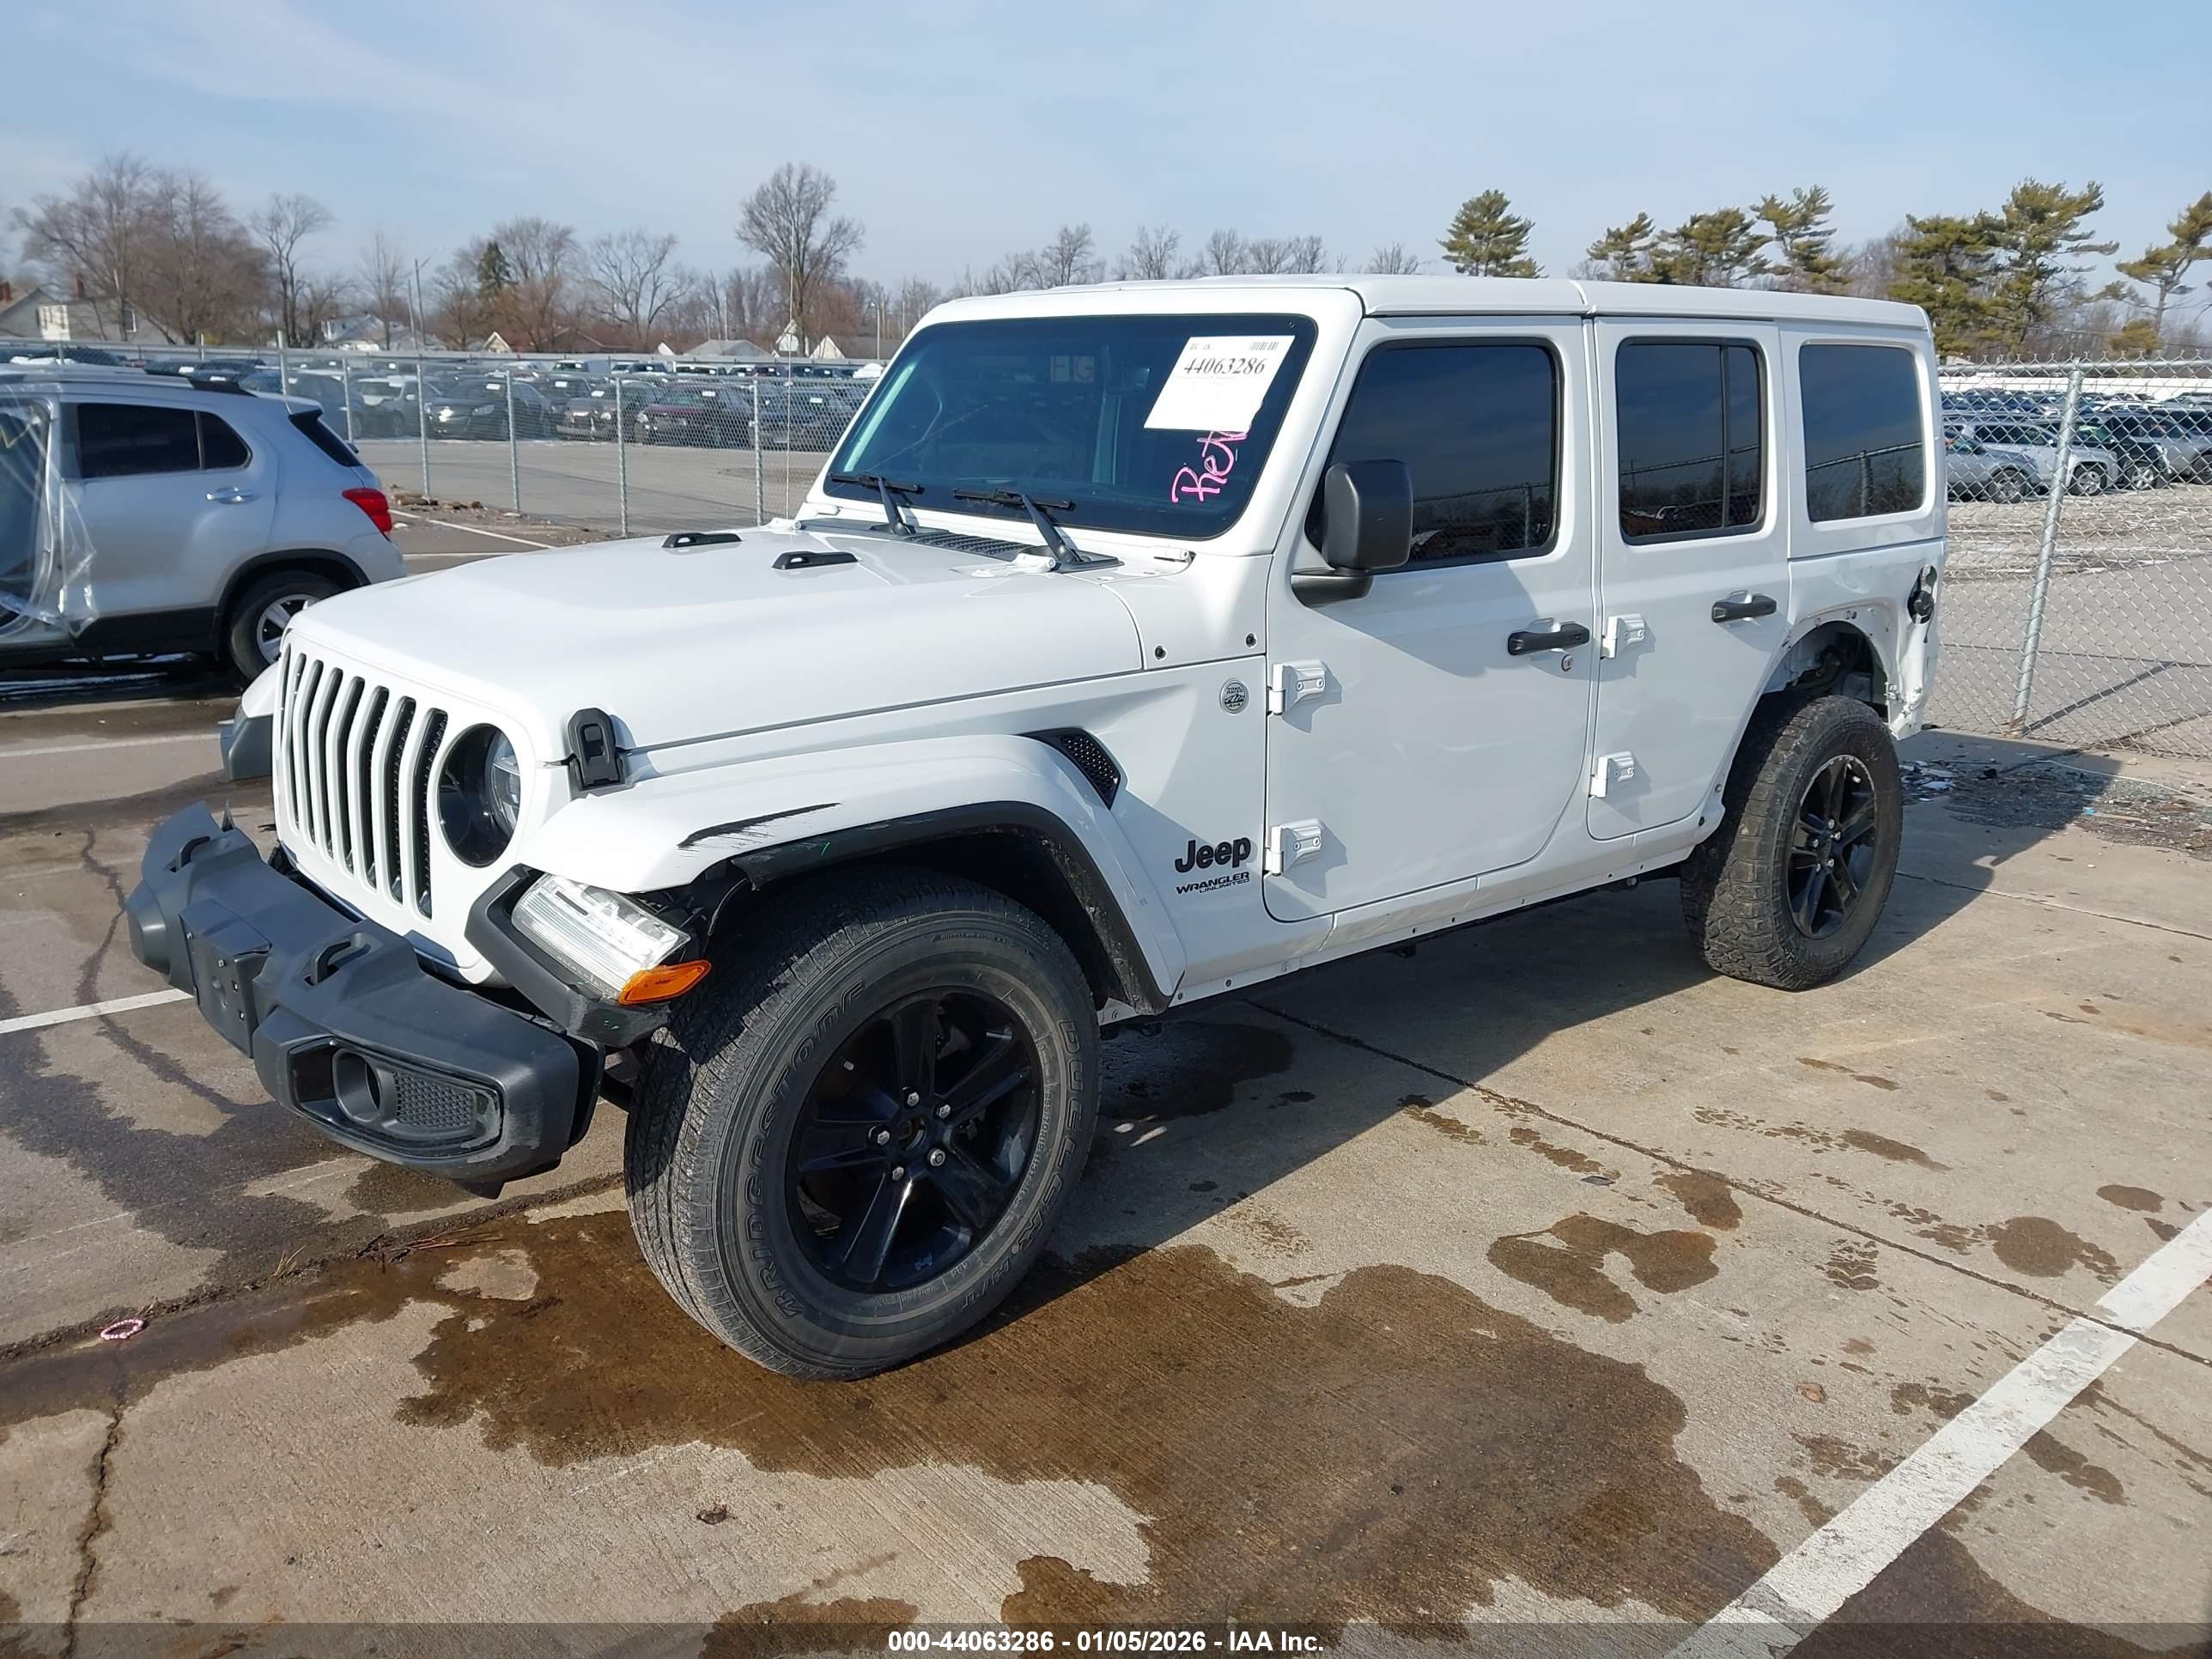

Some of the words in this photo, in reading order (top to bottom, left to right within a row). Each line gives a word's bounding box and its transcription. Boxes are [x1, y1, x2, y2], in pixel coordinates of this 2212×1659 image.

[1183, 358, 1267, 374] 44063286
[1175, 837, 1250, 872] Jeep
[1176, 872, 1249, 894] WRANGLER
[1199, 879, 1249, 893] UNLIMITED
[744, 979, 863, 1319] BRIDGESTONE
[1018, 1020, 1084, 1250] DUELER
